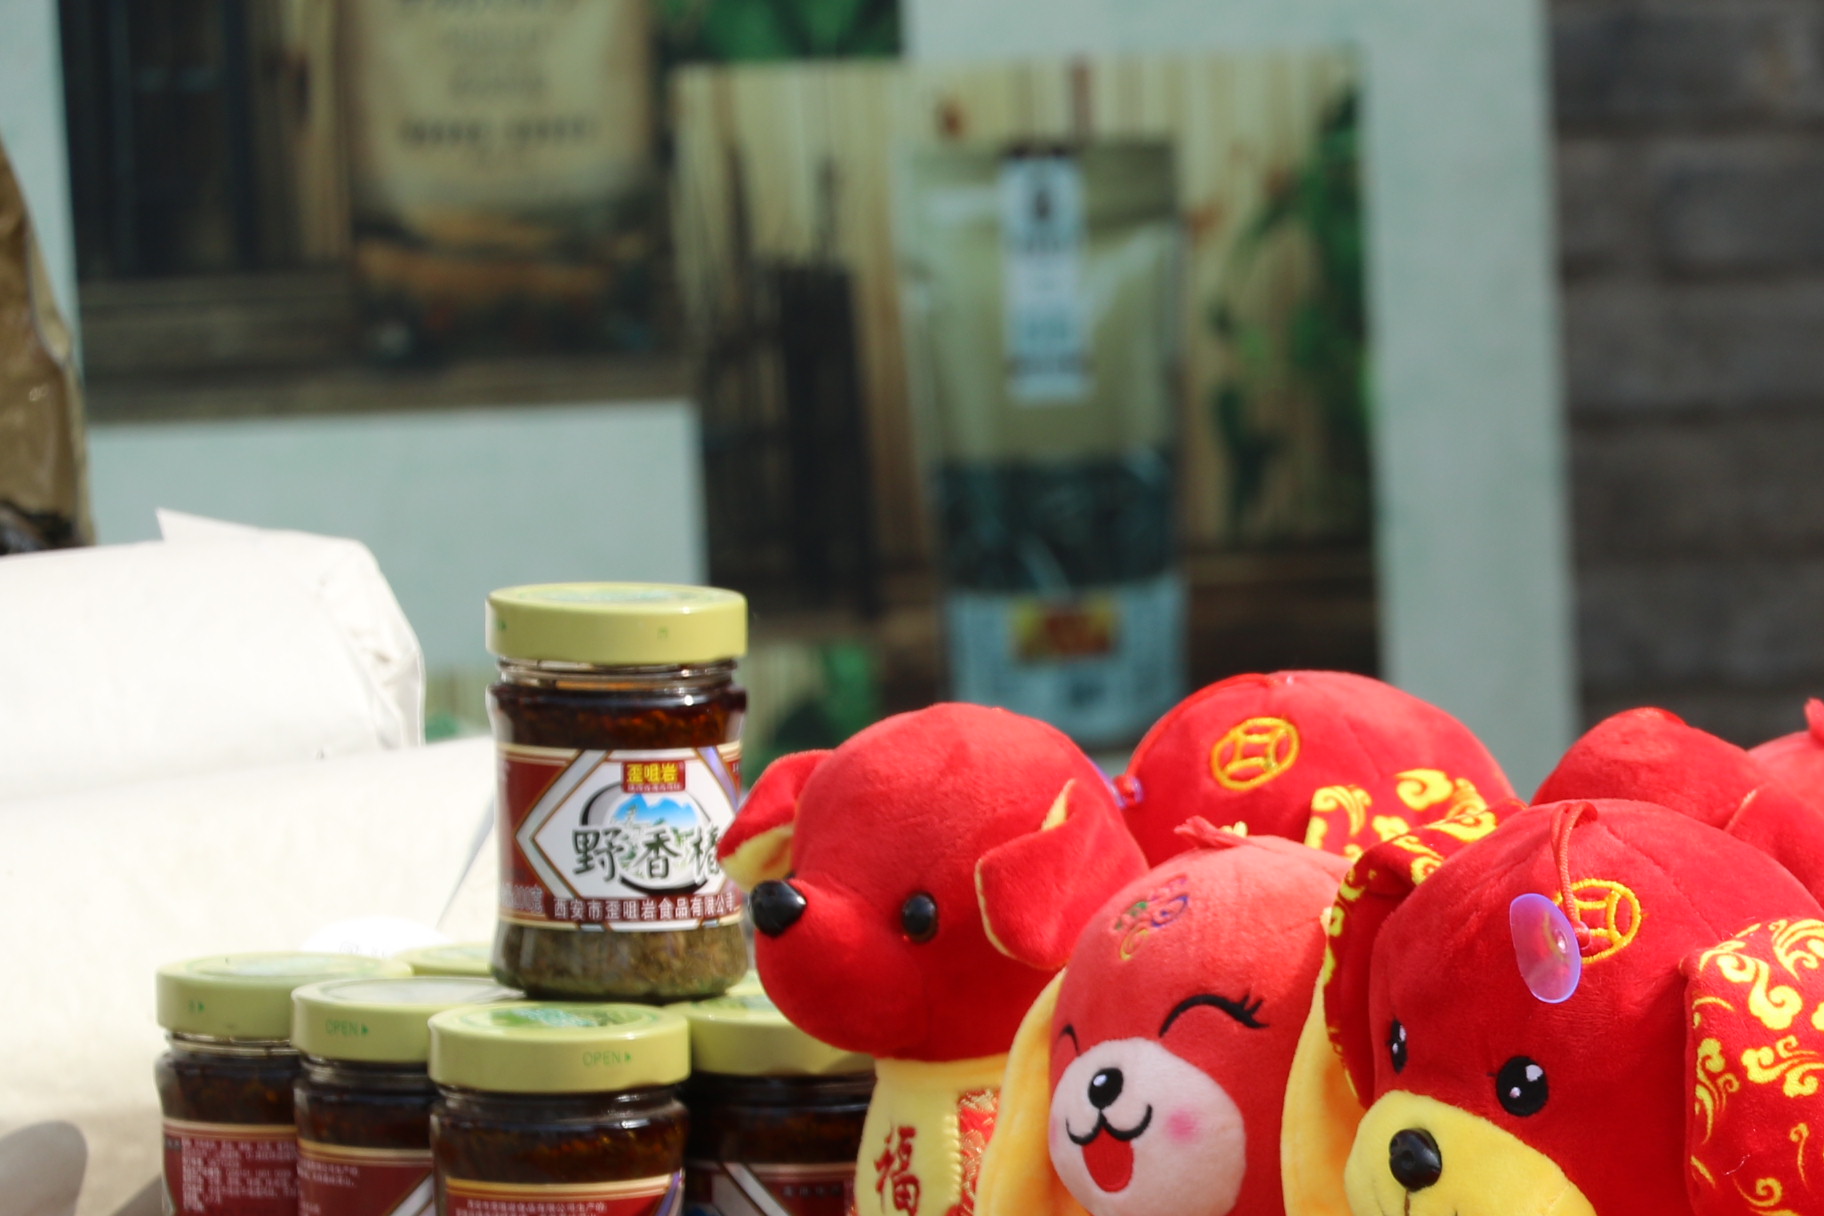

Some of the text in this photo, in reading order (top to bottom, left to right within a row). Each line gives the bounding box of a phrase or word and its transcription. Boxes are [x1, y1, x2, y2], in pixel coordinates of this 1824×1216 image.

[626, 763, 679, 784] 歪咀岩
[572, 826, 720, 884] 野香椿
[325, 1018, 358, 1038] OPEN
[582, 1049, 622, 1067] OPEN
